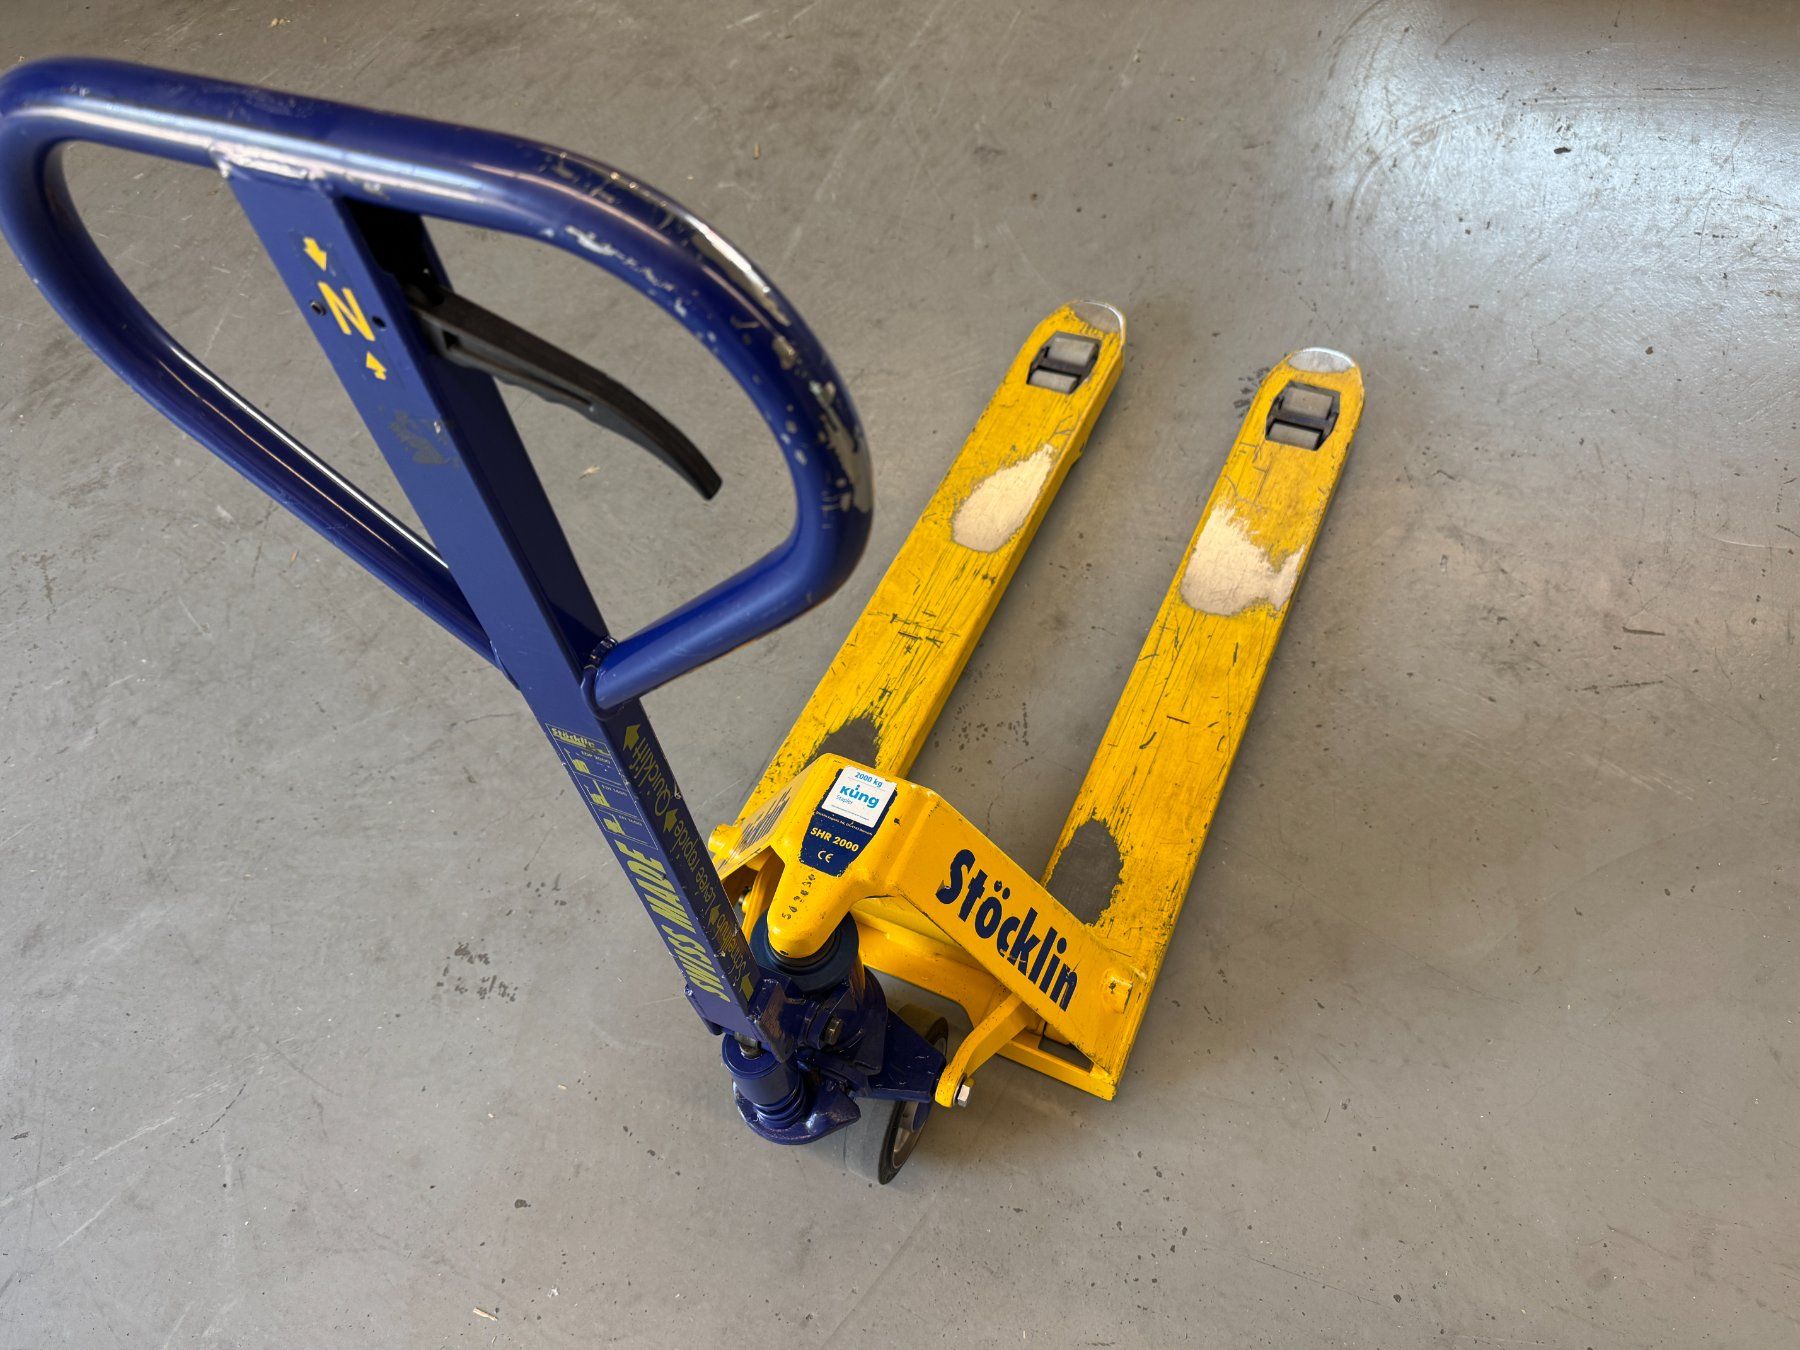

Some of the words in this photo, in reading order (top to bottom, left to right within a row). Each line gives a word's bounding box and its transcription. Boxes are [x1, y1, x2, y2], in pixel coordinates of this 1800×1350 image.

[628, 737, 671, 816] Quicklift
[854, 771, 873, 783] 2000
[872, 778, 883, 788] kg
[671, 820, 701, 872] rapide
[810, 827, 833, 842] SHR
[832, 836, 860, 852] 2000
[614, 839, 697, 934] MADE
[661, 924, 731, 1003] SWISS
[935, 849, 1078, 1012] Stöcklin
